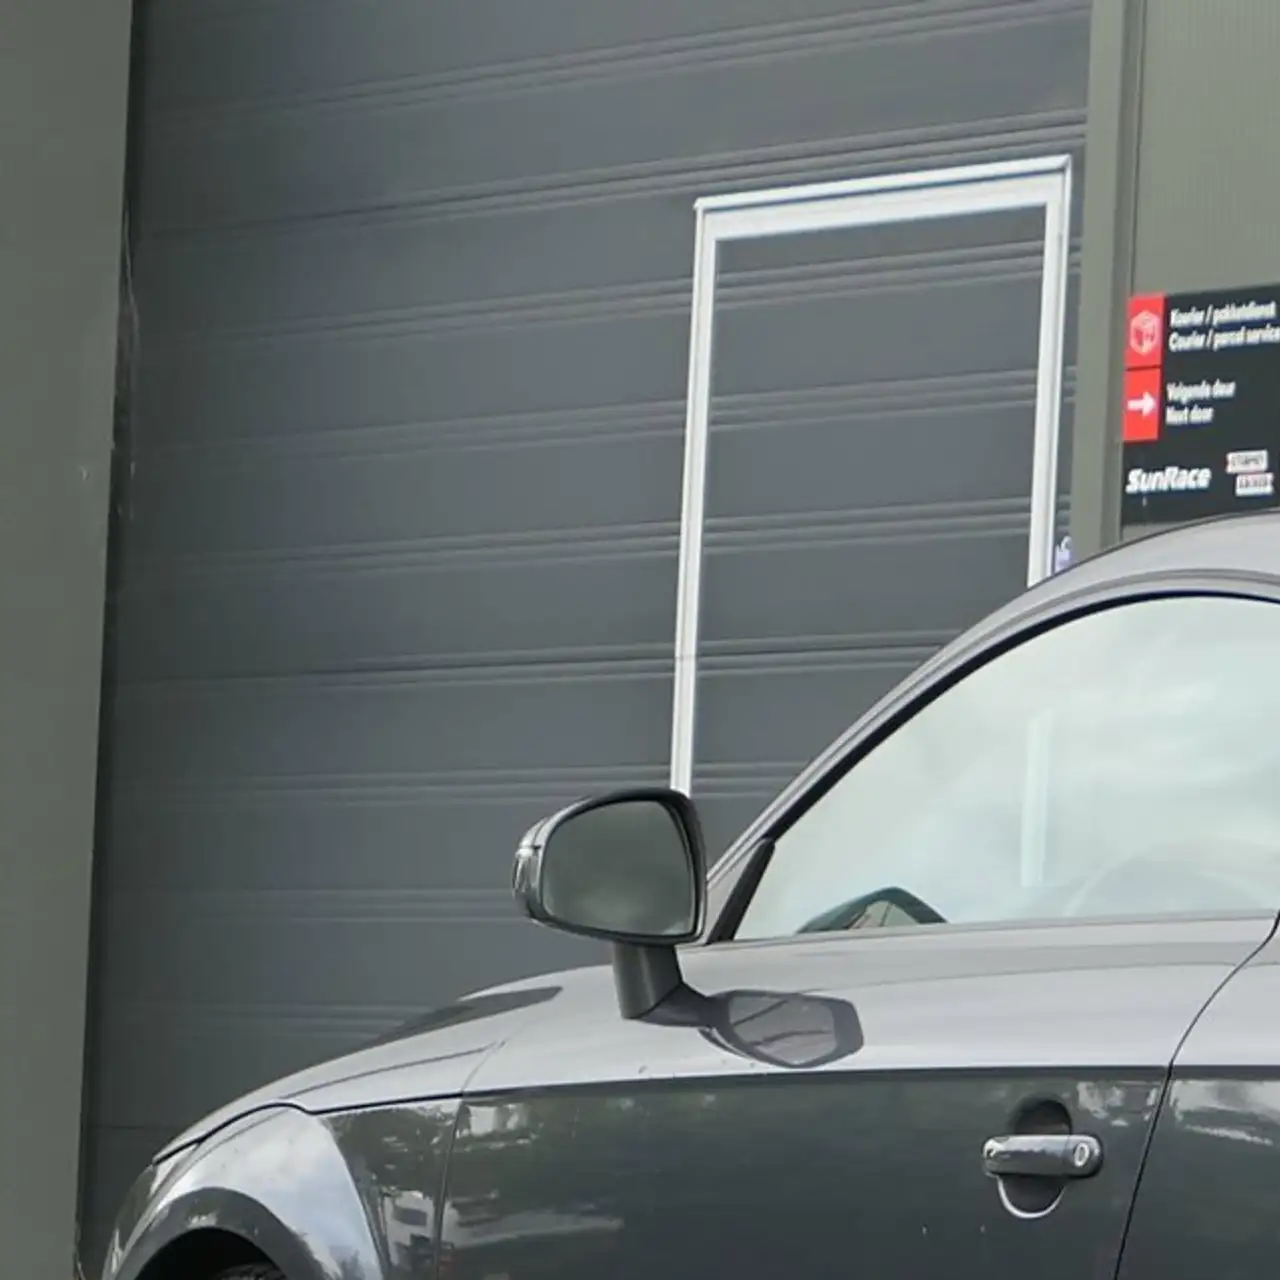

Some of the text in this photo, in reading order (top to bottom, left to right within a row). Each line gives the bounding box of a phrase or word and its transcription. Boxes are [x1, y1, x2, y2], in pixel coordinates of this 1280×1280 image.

[1169, 330, 1205, 352] Courier
[1213, 326, 1245, 352] parcel
[1166, 379, 1210, 404] Volgende
[1165, 406, 1188, 425] Next
[1125, 466, 1212, 494] SunRace
